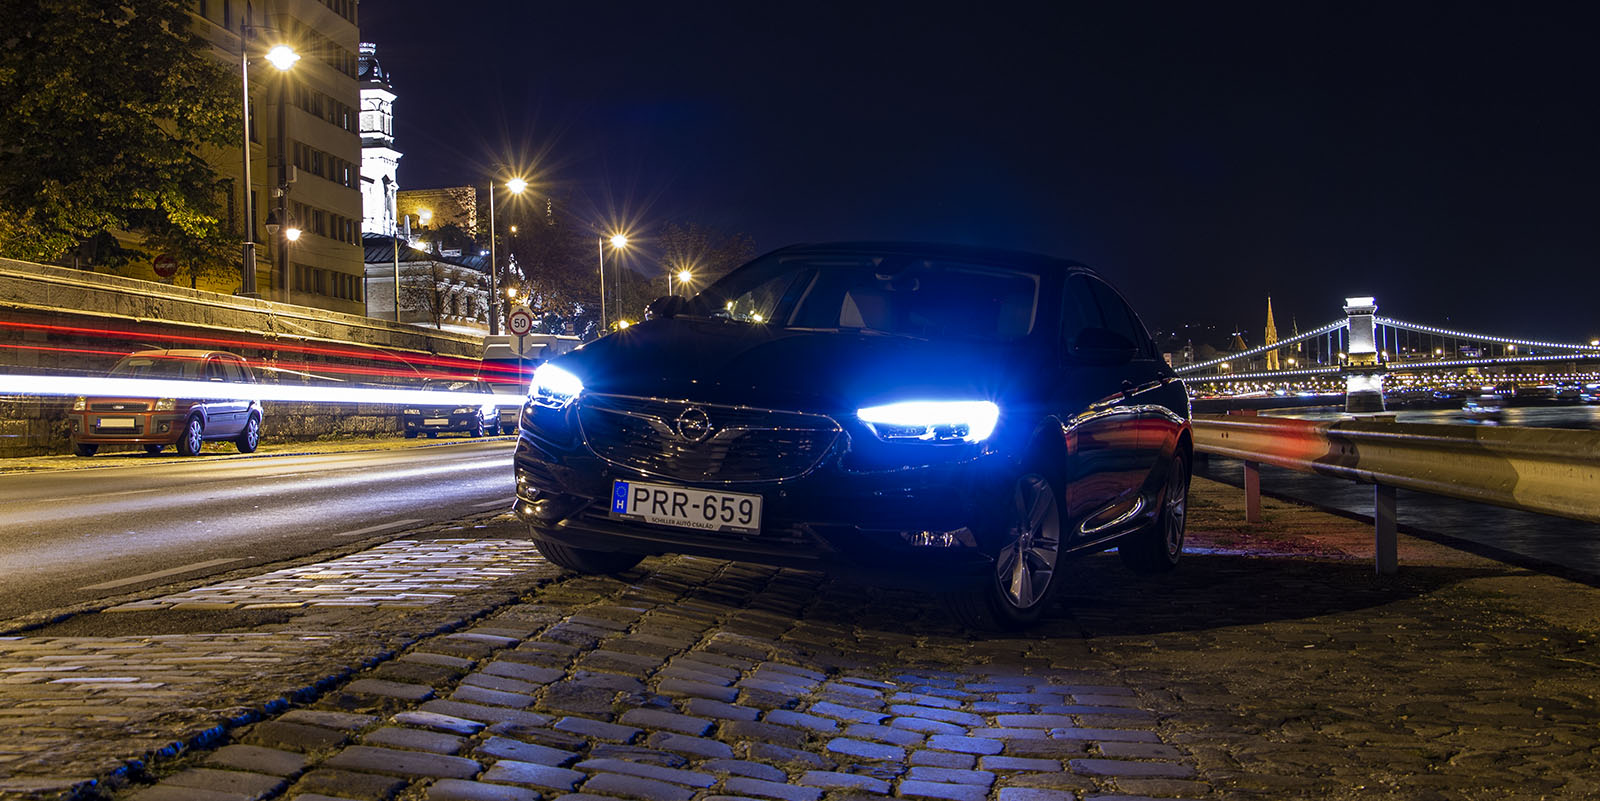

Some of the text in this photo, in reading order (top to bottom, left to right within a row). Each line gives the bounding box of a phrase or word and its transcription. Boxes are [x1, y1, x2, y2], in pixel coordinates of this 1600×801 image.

[514, 318, 526, 328] 50
[616, 500, 624, 509] H
[632, 487, 754, 525] PRR-659
[651, 517, 675, 525] SCHILLER
